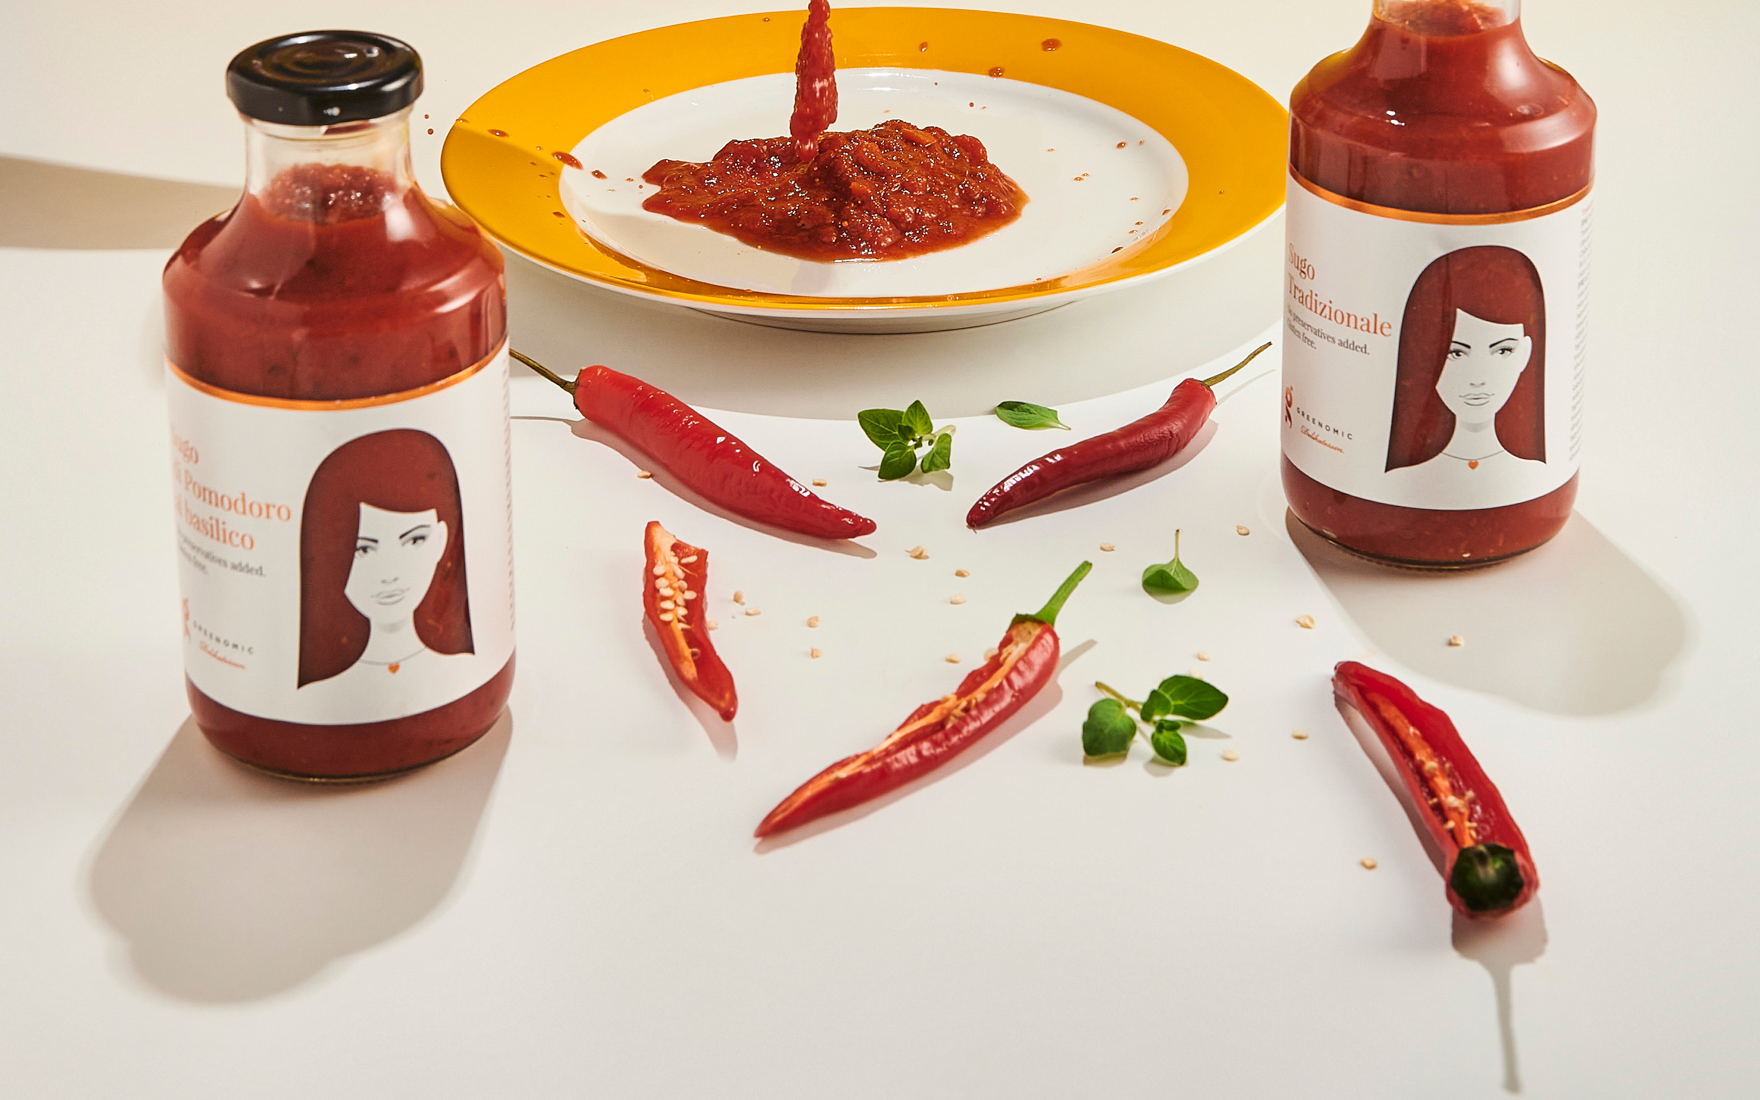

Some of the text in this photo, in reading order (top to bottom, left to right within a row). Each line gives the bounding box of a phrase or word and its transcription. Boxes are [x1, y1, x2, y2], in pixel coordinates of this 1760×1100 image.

[1287, 241, 1316, 281] Sugo
[1287, 271, 1393, 338] Tradizionale
[1337, 337, 1371, 356] added.
[1296, 405, 1354, 441] GREENOMIC
[184, 468, 292, 523] Pomodoro
[184, 498, 256, 551] basilico
[229, 558, 268, 578] added.
